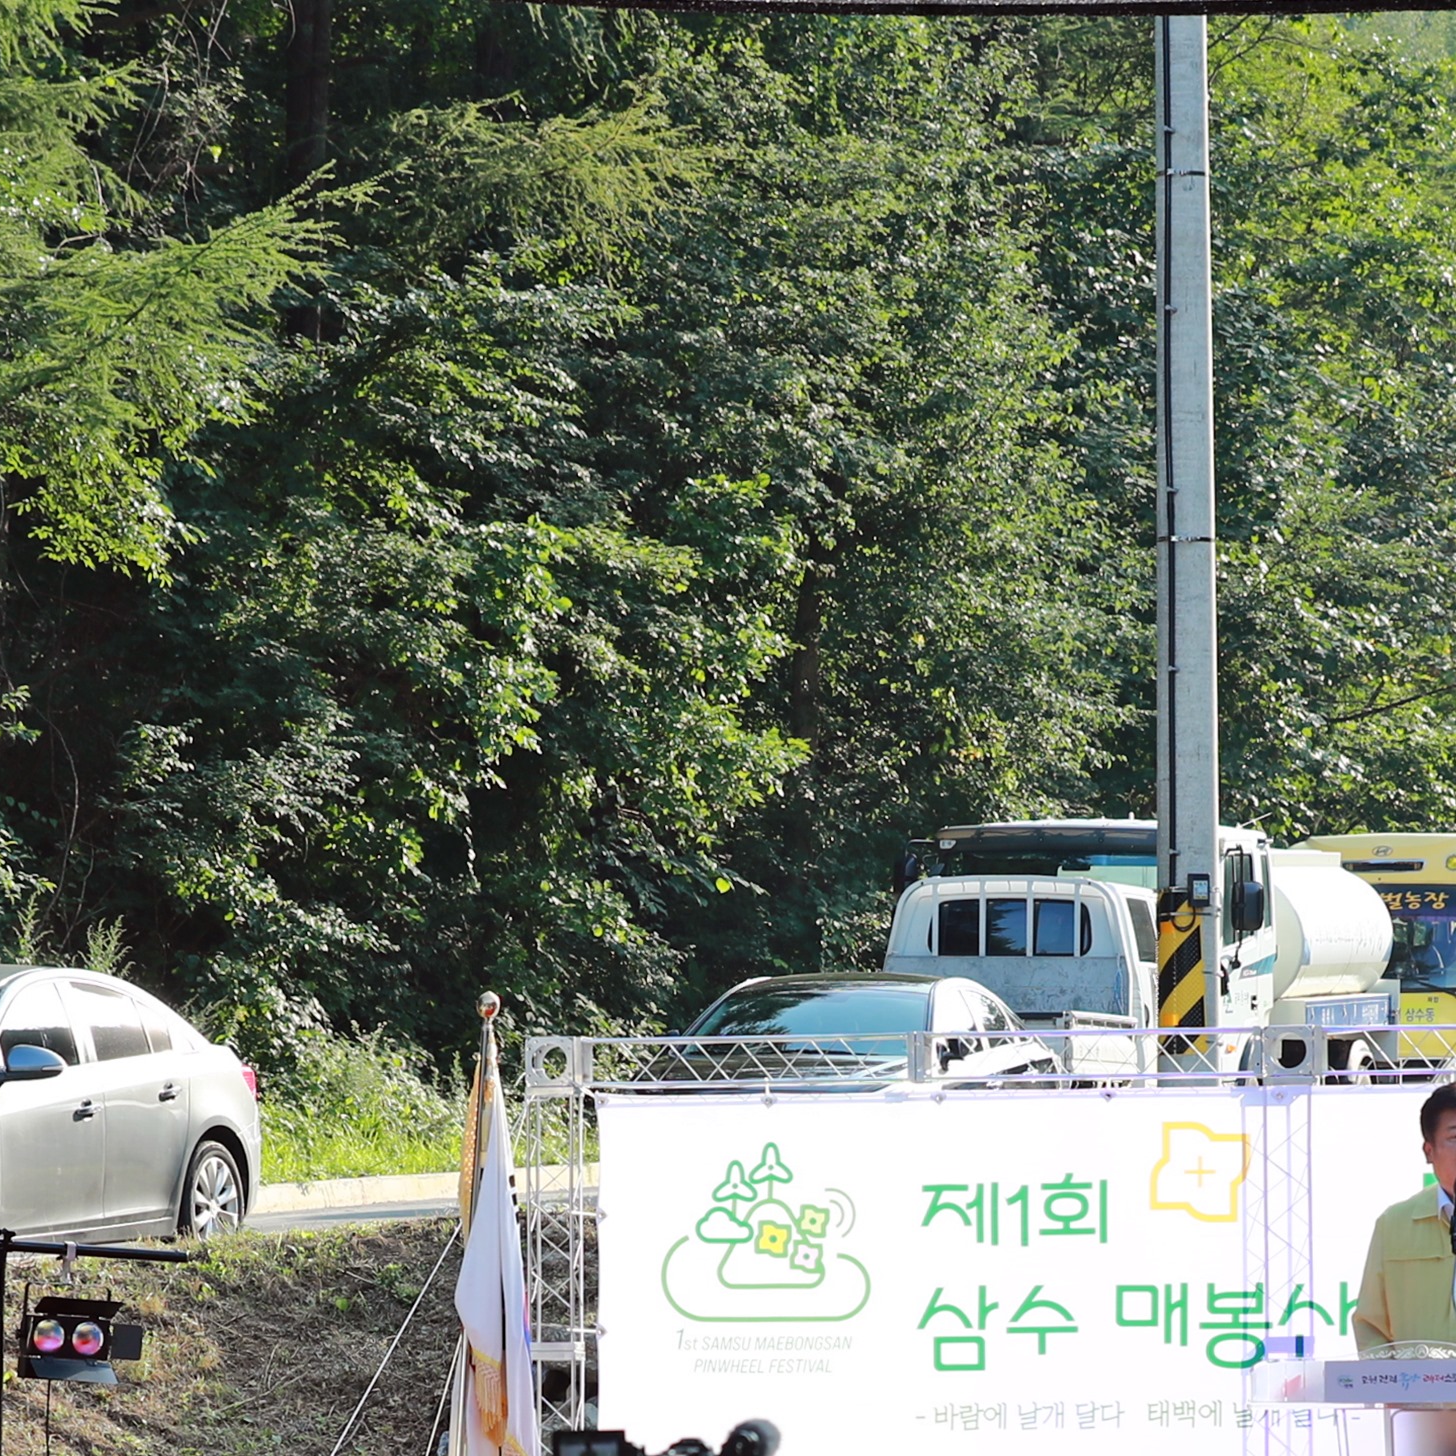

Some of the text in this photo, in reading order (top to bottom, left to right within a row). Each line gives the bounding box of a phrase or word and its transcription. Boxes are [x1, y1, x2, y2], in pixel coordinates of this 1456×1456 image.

[920, 1172, 1109, 1247] 제1회
[675, 1328, 853, 1351] 1st SAMSU MAEBONGSAN
[916, 1284, 1079, 1371] 삼수
[694, 1358, 832, 1374] PINWHEEL FESTIVAL
[934, 1401, 1008, 1431] 바람에
[1017, 1401, 1066, 1430] 날개
[1076, 1400, 1125, 1429] 달다
[1147, 1399, 1223, 1428] 태백에
